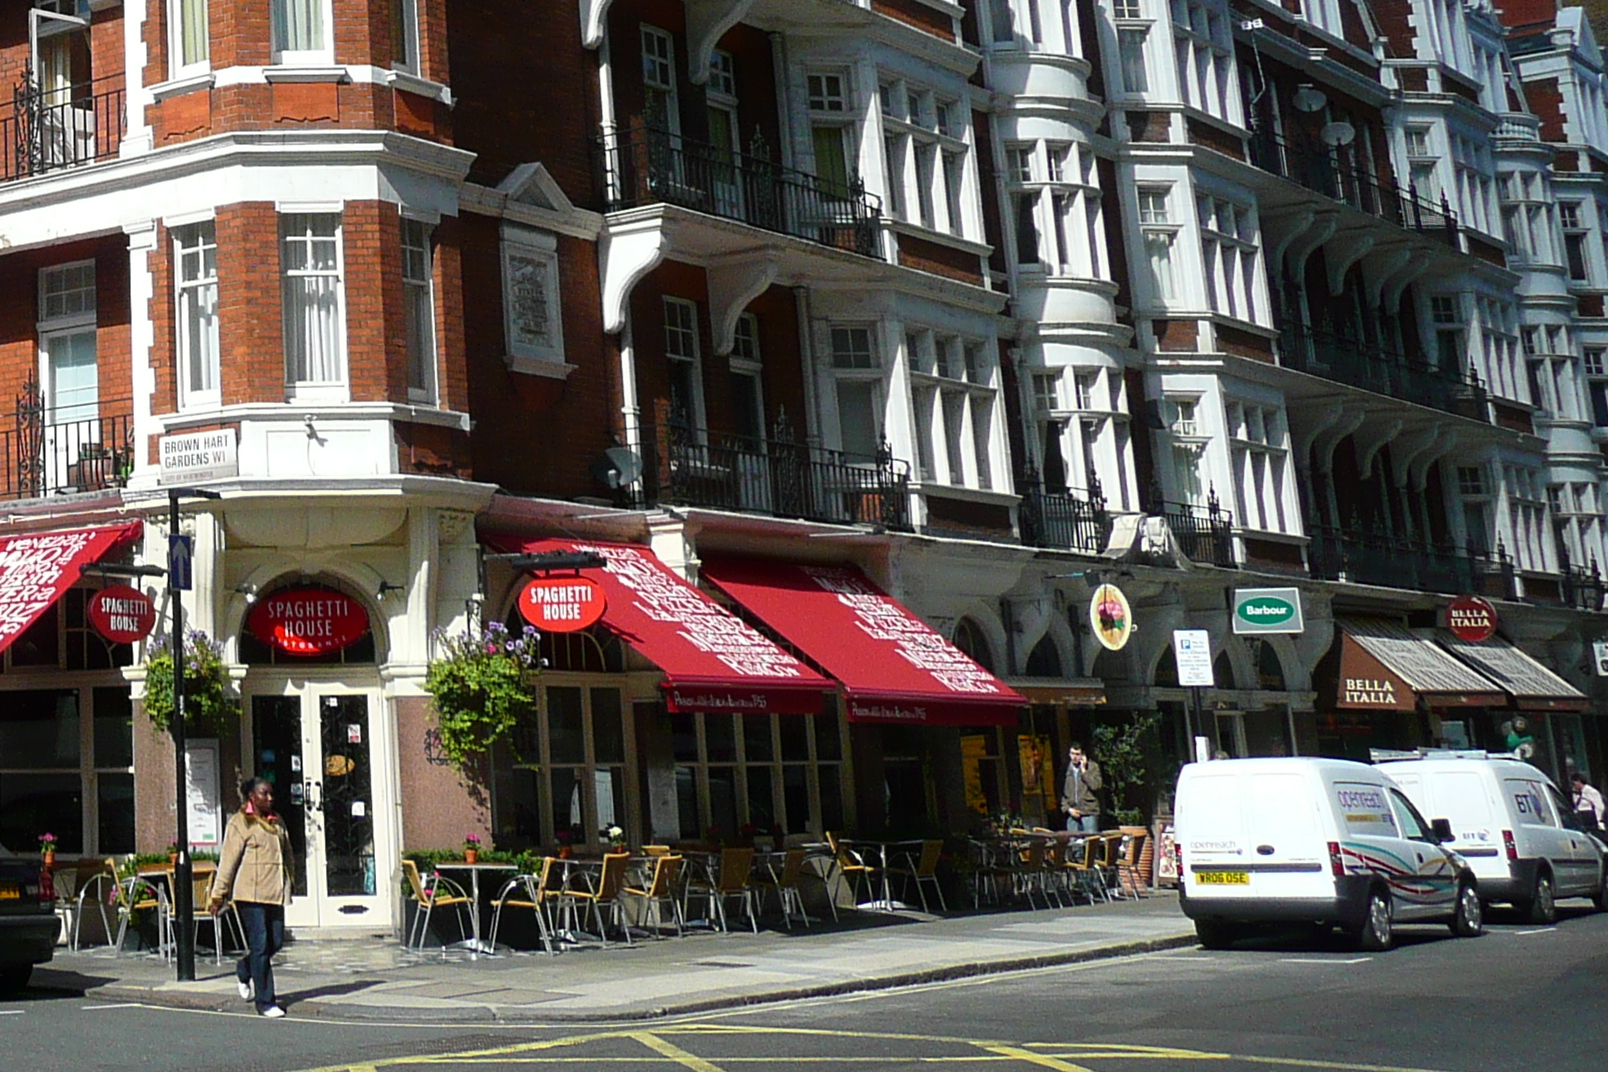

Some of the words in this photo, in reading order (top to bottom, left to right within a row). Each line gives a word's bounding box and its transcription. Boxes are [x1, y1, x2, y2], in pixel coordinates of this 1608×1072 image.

[164, 438, 199, 454] BROWN
[203, 434, 229, 448] HART
[164, 452, 210, 469] GARDENS
[530, 585, 593, 604] SPAGHETTI
[100, 597, 148, 616] SPAGHETTI
[267, 600, 349, 618] SPAGHETTI
[542, 603, 582, 621] HOUSE
[1245, 604, 1288, 616] Barbour
[1451, 609, 1489, 618] BELLA
[110, 614, 139, 633] HOUSE
[284, 619, 333, 638] HOUSE
[1450, 617, 1492, 627] ITALIA
[270, 635, 347, 649] RISTORANTE
[1345, 678, 1394, 692] BELLA
[1345, 691, 1397, 704] ITALIA
[1337, 789, 1384, 811] openreach
[1514, 793, 1533, 814] BT
[1189, 840, 1237, 850] openreach
